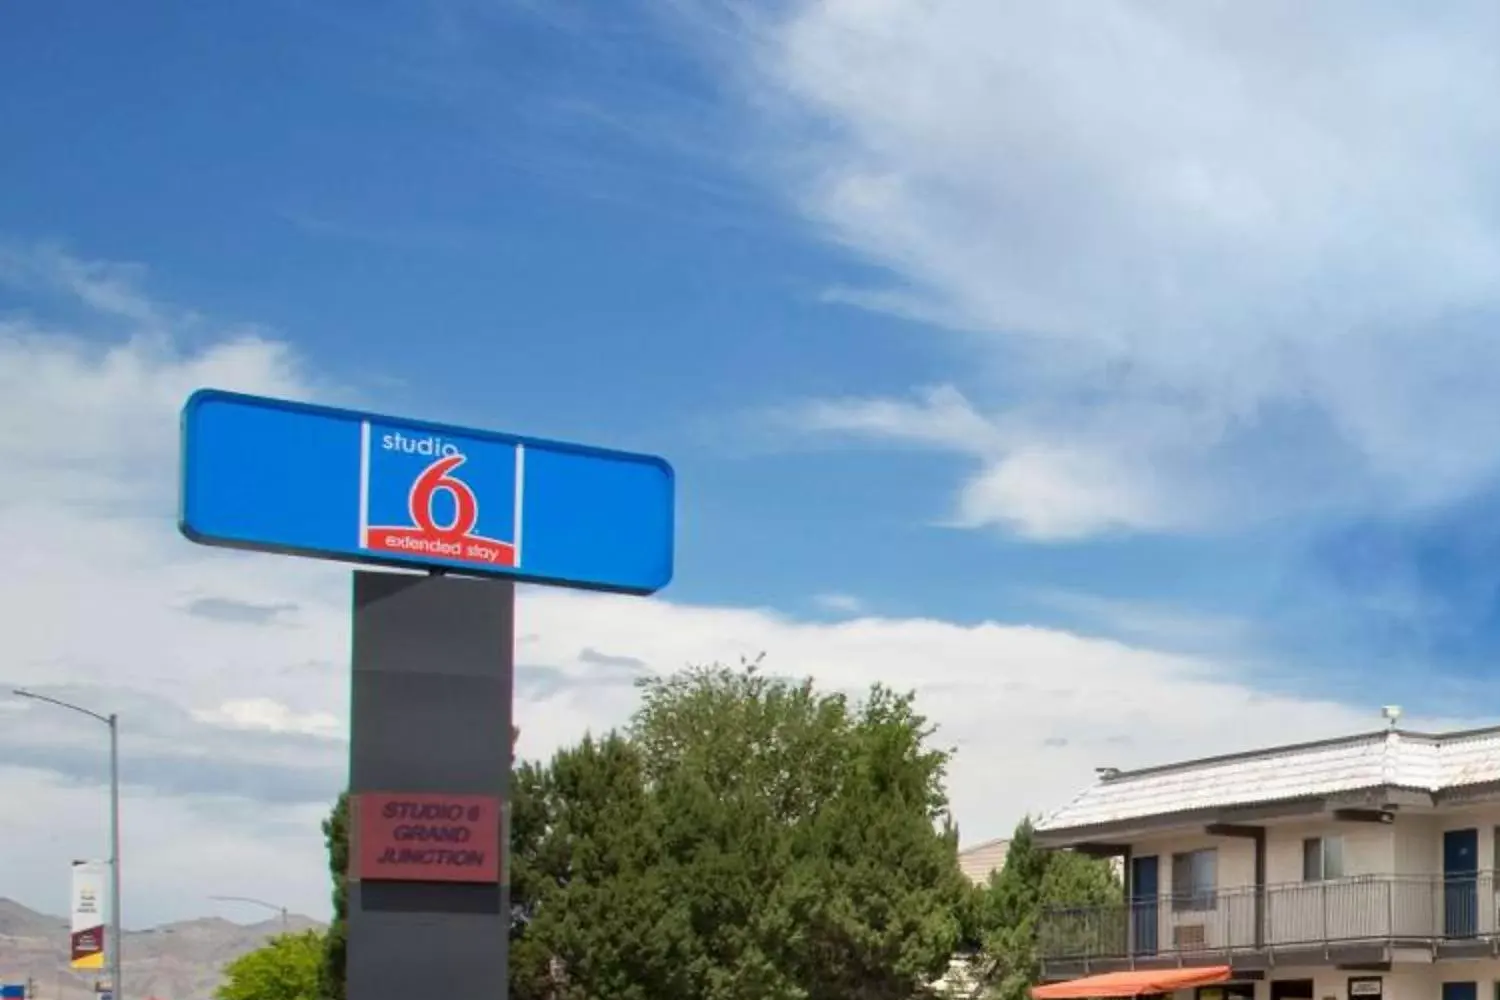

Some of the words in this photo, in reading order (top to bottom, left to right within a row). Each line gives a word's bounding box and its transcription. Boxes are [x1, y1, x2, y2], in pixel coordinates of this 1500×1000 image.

[382, 432, 459, 458] studio
[408, 454, 478, 534] 6
[384, 535, 462, 556] extended
[467, 544, 500, 562] stay
[382, 802, 464, 821] STUDIO
[393, 825, 471, 843] GRAND
[376, 847, 485, 866] JUNCTION
